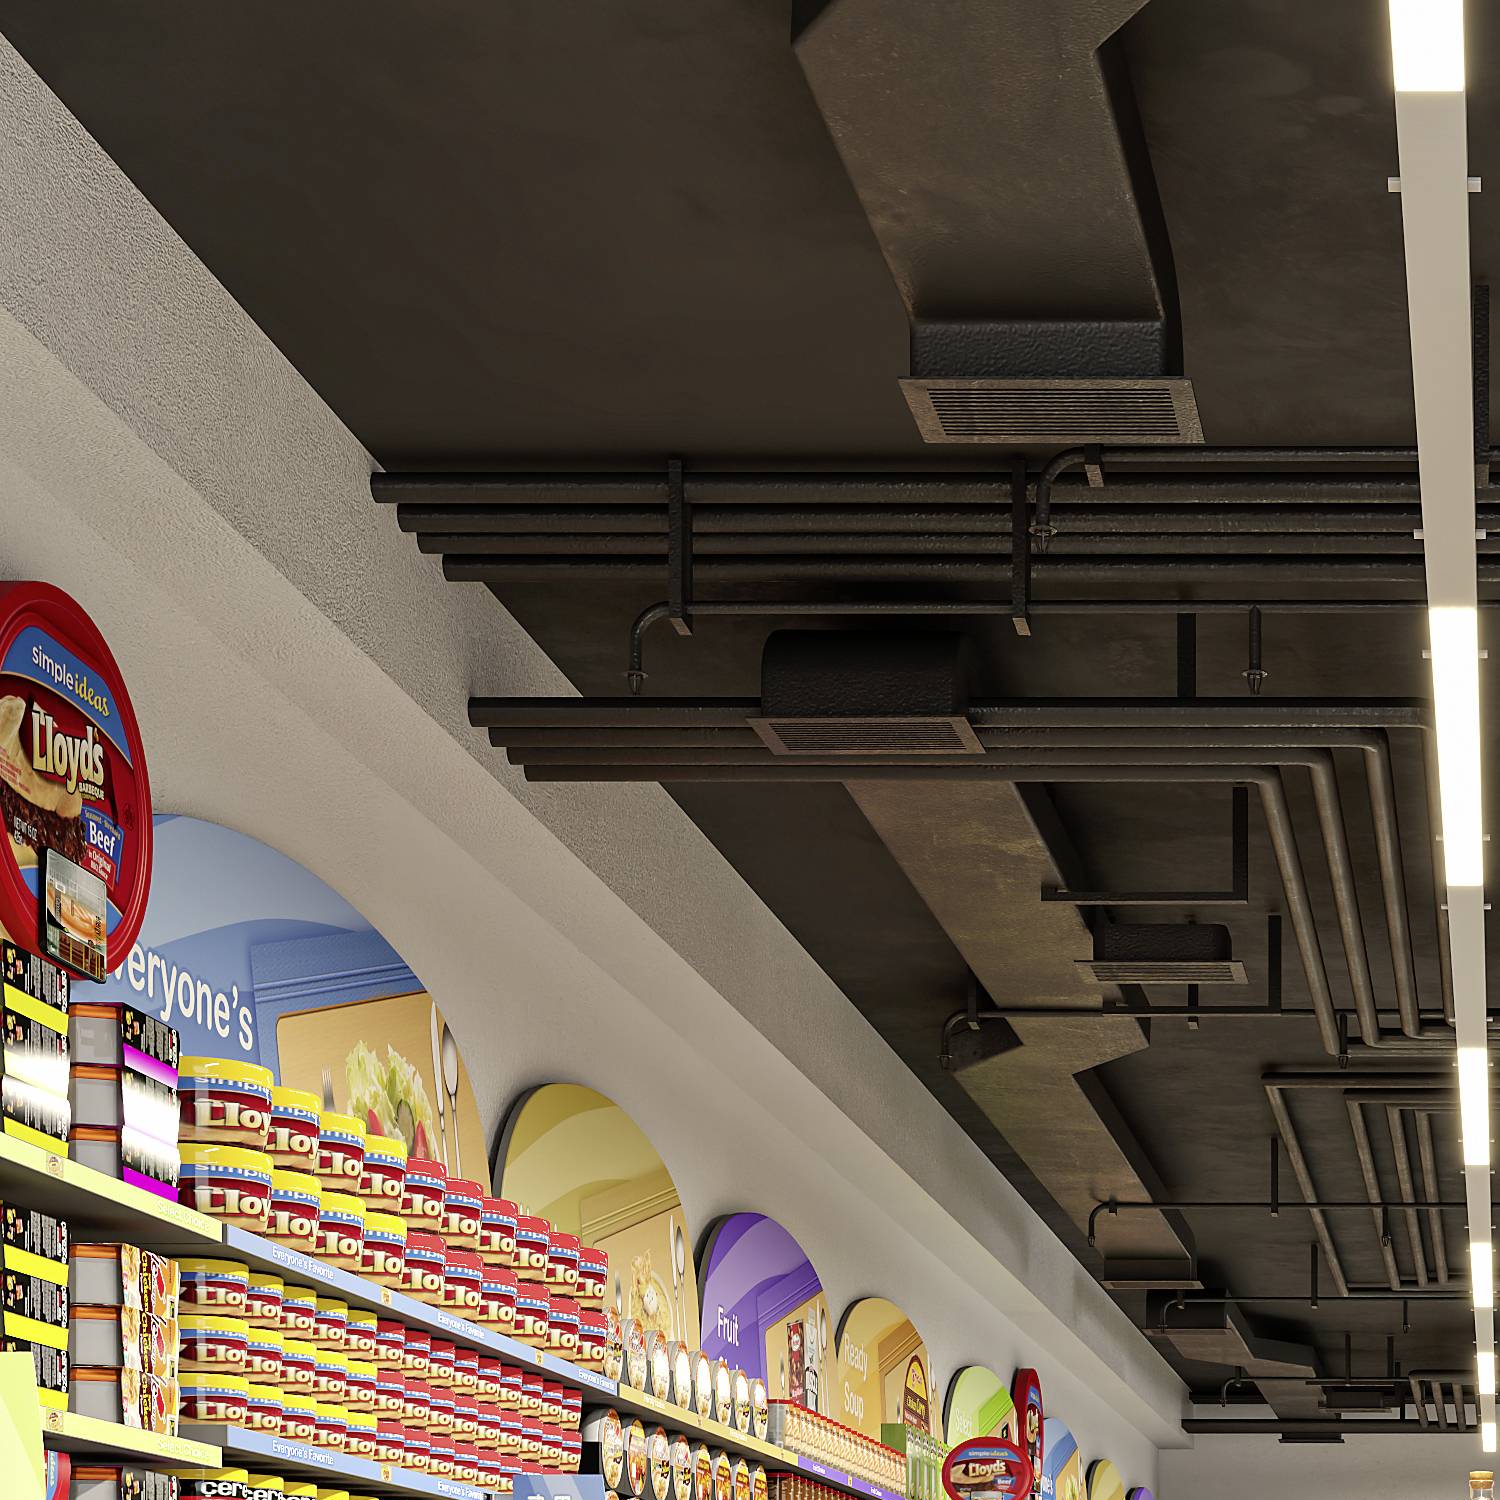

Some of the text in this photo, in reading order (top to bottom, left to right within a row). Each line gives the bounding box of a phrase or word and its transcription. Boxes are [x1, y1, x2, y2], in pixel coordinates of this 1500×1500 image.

[32, 645, 110, 717] simple ideas
[31, 709, 104, 794] Lloyd's
[89, 821, 116, 858] Beef
[193, 1099, 271, 1138] Lloy
[193, 1187, 271, 1224] Lloy
[272, 1245, 334, 1281] Everyone's Favorite
[717, 1305, 739, 1347] Fruit
[844, 1332, 868, 1382] Ready
[844, 1383, 865, 1426] Soup
[272, 1440, 334, 1466] Everyone's Favorite
